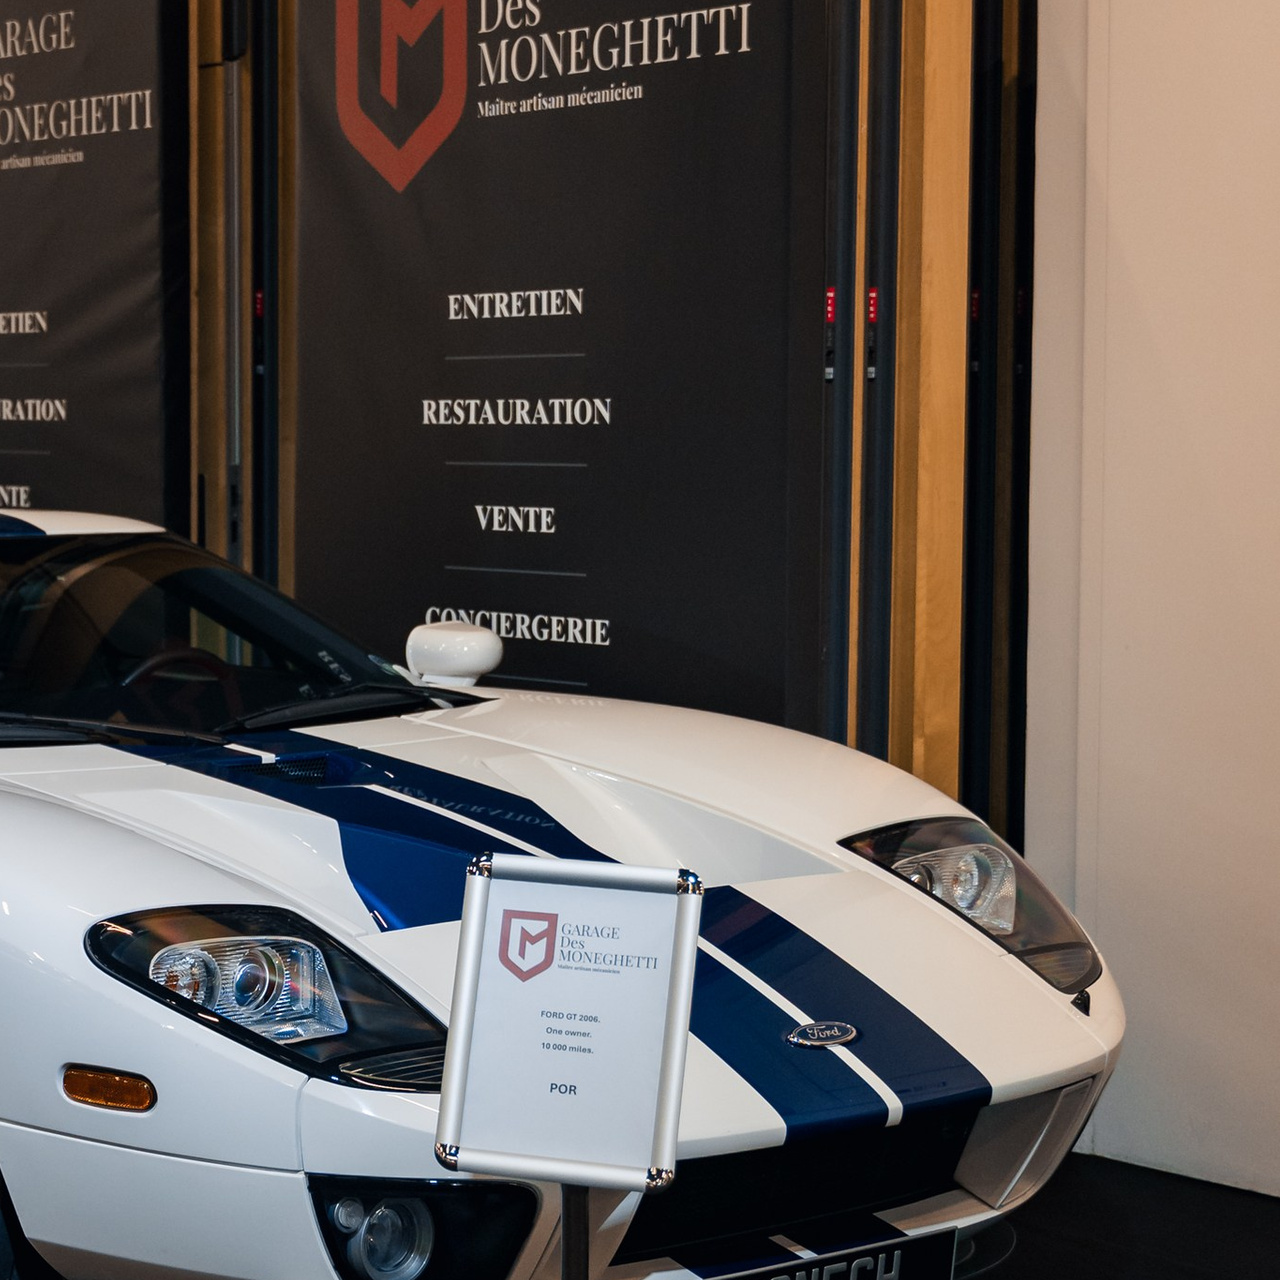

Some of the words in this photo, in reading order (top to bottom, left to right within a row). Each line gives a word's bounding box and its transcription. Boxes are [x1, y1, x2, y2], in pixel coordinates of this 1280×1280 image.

[477, 2, 752, 87] MONEGHETTI
[519, 92, 564, 113] artisan
[567, 82, 643, 107] mécanicien
[0, 154, 32, 170] artisan
[448, 288, 584, 320] ENTRETIEN
[422, 398, 611, 425] RESTAURATION
[475, 505, 556, 533] VENTE
[561, 923, 620, 939] GARAGE
[560, 936, 585, 949] Des
[559, 949, 658, 969] MONEGHETTI
[540, 1010, 565, 1020] FORD
[566, 1013, 577, 1021] GT
[579, 1014, 601, 1023] 2006.
[546, 1026, 563, 1035] One
[564, 1030, 592, 1038] owner.
[806, 1025, 842, 1040] Ford
[542, 1042, 551, 1050] 10
[552, 1043, 567, 1051] 000
[568, 1046, 594, 1054] miles.
[549, 1082, 577, 1096] POR
